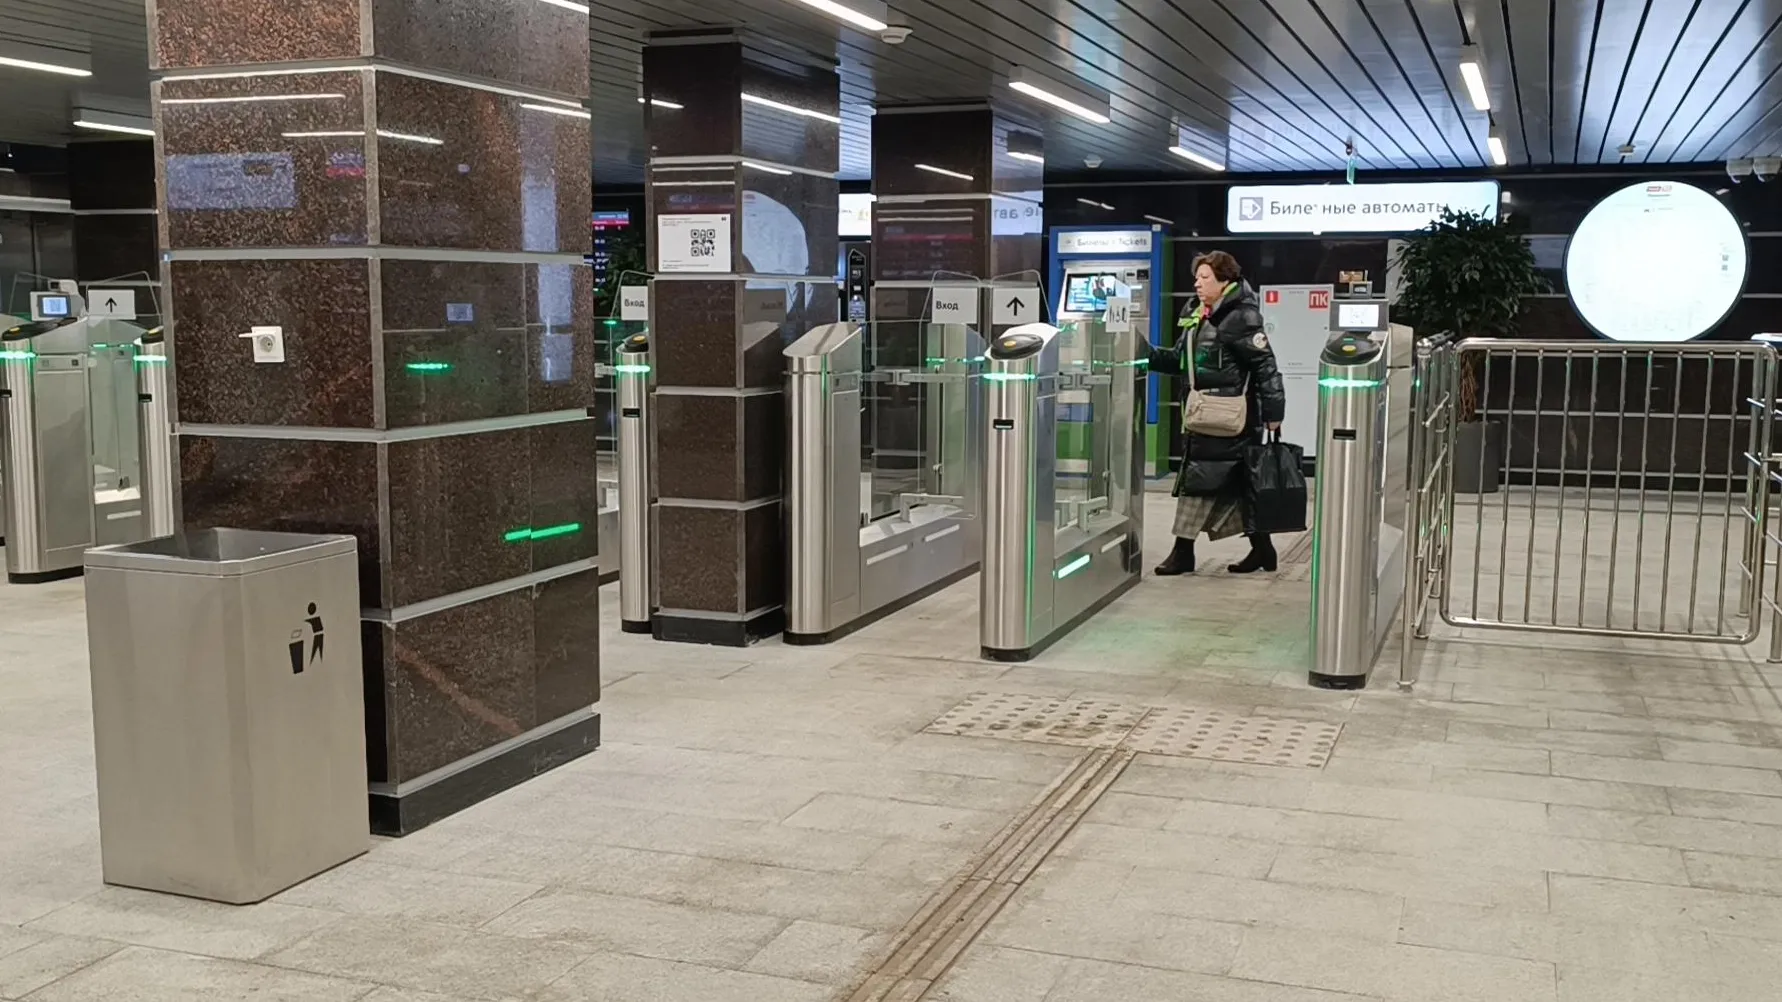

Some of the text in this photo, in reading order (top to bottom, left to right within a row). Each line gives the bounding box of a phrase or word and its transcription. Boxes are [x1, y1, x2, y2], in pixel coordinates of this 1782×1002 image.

[1270, 201, 1356, 215] Биленые
[624, 299, 645, 308] Вход
[1310, 293, 1329, 306] ПК
[936, 301, 959, 311] Вход
